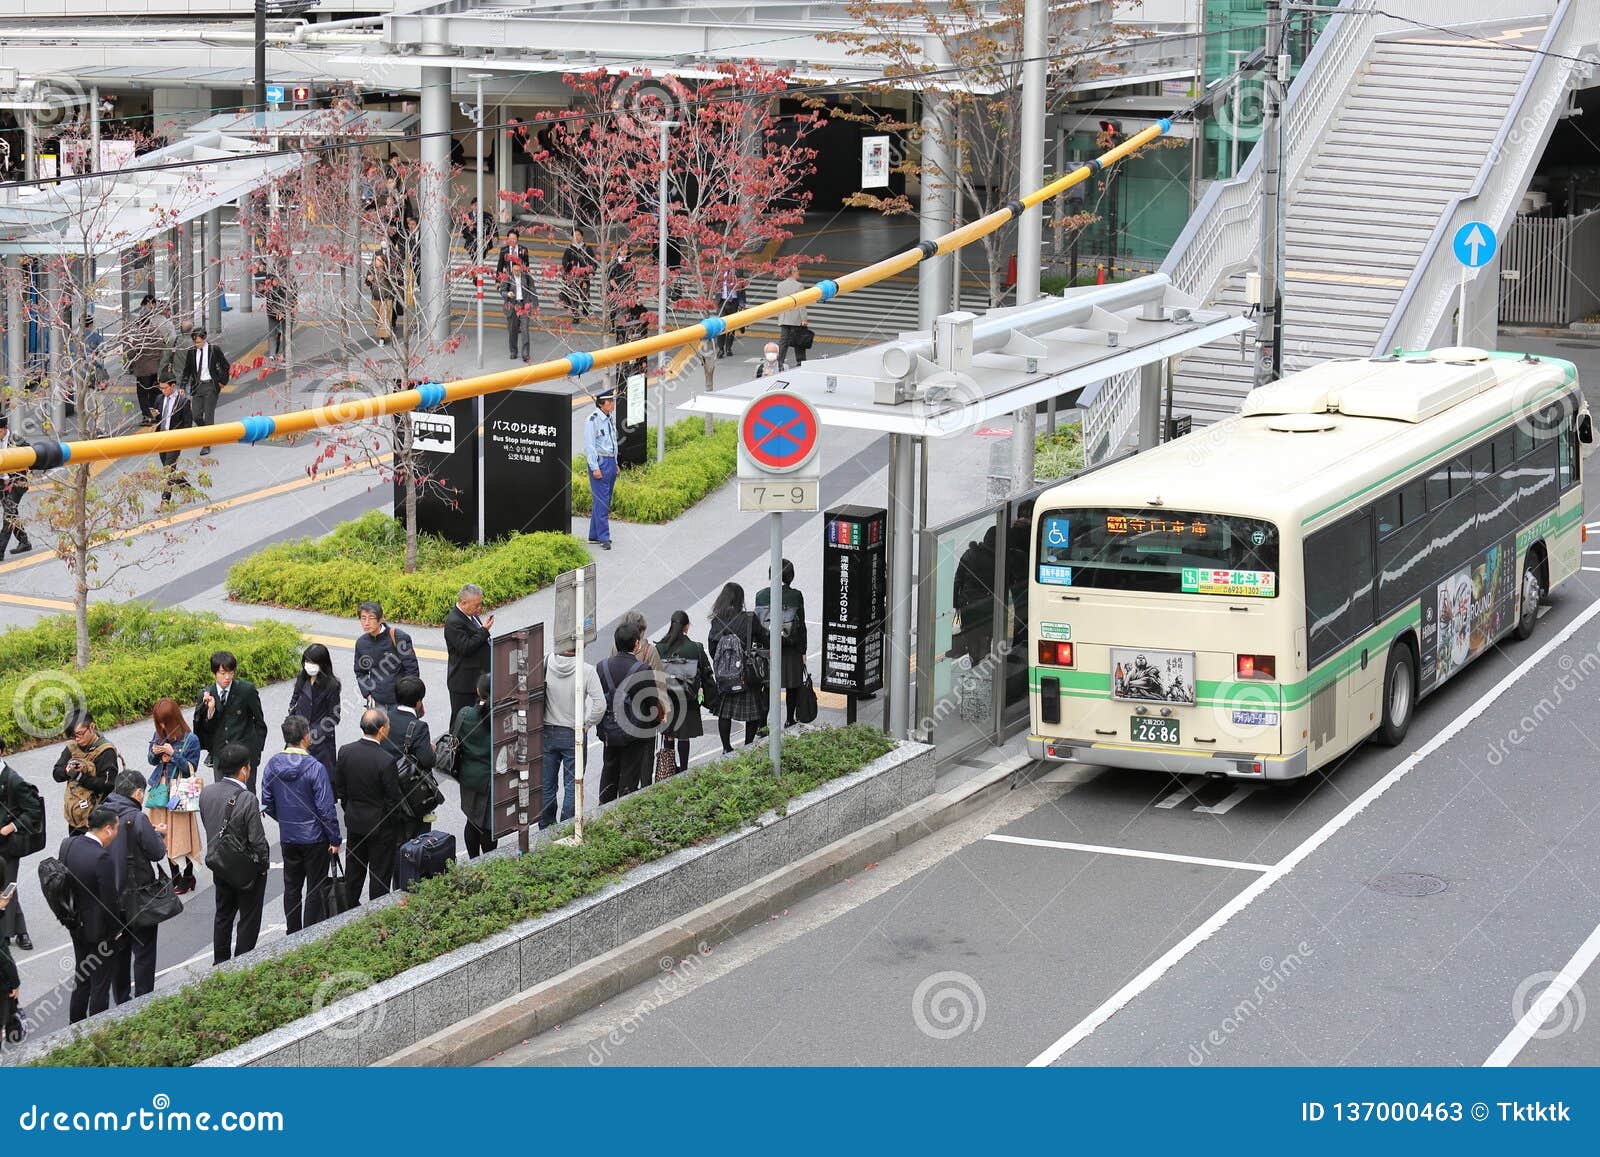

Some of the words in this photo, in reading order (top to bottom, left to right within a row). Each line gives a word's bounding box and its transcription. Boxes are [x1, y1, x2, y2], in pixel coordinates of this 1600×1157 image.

[493, 420, 557, 437] バスのりば案内
[493, 434, 504, 442] Bus
[505, 436, 519, 445] Stop
[520, 437, 556, 448] Information
[1140, 725, 1178, 743] 26-86
